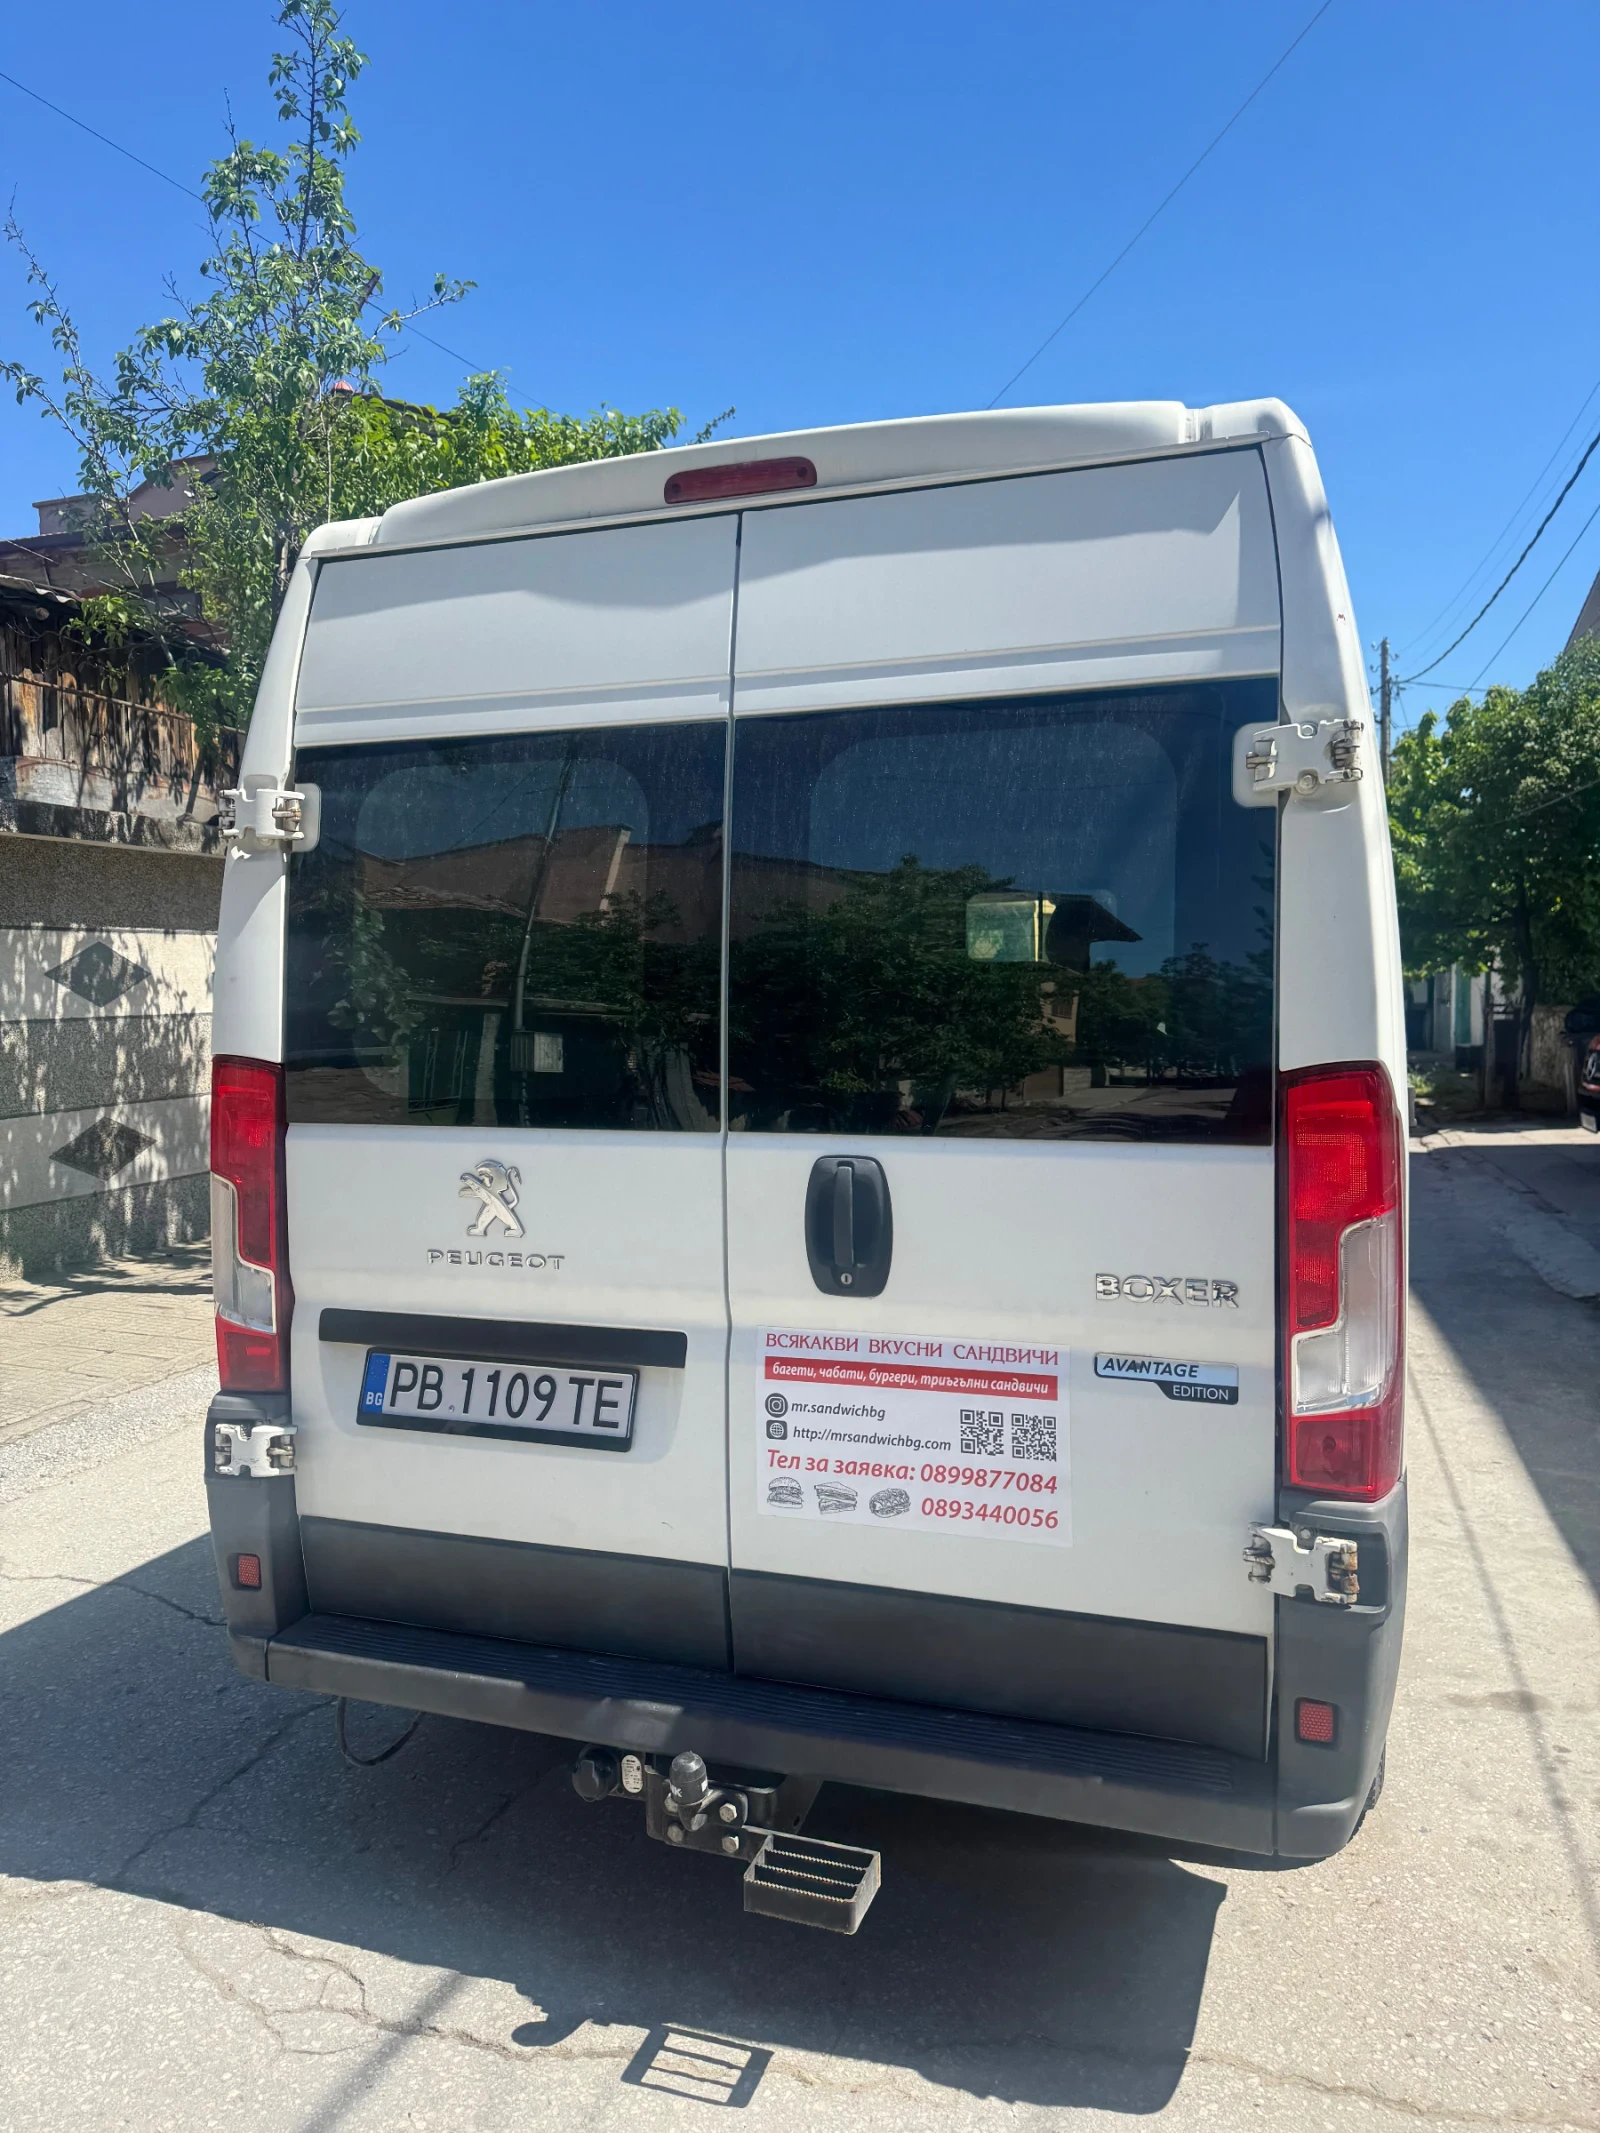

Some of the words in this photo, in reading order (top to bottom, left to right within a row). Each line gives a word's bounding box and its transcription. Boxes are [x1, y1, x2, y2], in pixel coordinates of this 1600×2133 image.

[427, 1248, 565, 1270] PEUGEOT
[1095, 1272, 1239, 1308] BOXER
[765, 1332, 858, 1353] ВСЯКАКВИ
[868, 1339, 943, 1358] ВКУСНИ
[953, 1344, 1059, 1366] САНДВИЧИ
[772, 1361, 817, 1379] багети,
[818, 1365, 867, 1382] чабати,
[868, 1368, 918, 1389] бургери,
[920, 1374, 988, 1392] триъгълни
[990, 1378, 1049, 1395] сандвичи
[1103, 1357, 1199, 1378] AVANTAGE
[366, 1391, 383, 1406] BG
[461, 1368, 558, 1422] 1109
[568, 1376, 624, 1429] TE
[1172, 1384, 1229, 1401] EDITION
[791, 1401, 886, 1421] mr.sandwichbg
[792, 1426, 951, 1451] http://mrsandwichbg.com
[767, 1448, 801, 1470] Тел
[804, 1456, 829, 1473] за
[832, 1457, 916, 1481] заявка:
[919, 1463, 1058, 1495] 0899877084
[920, 1496, 1059, 1530] 0893440056
